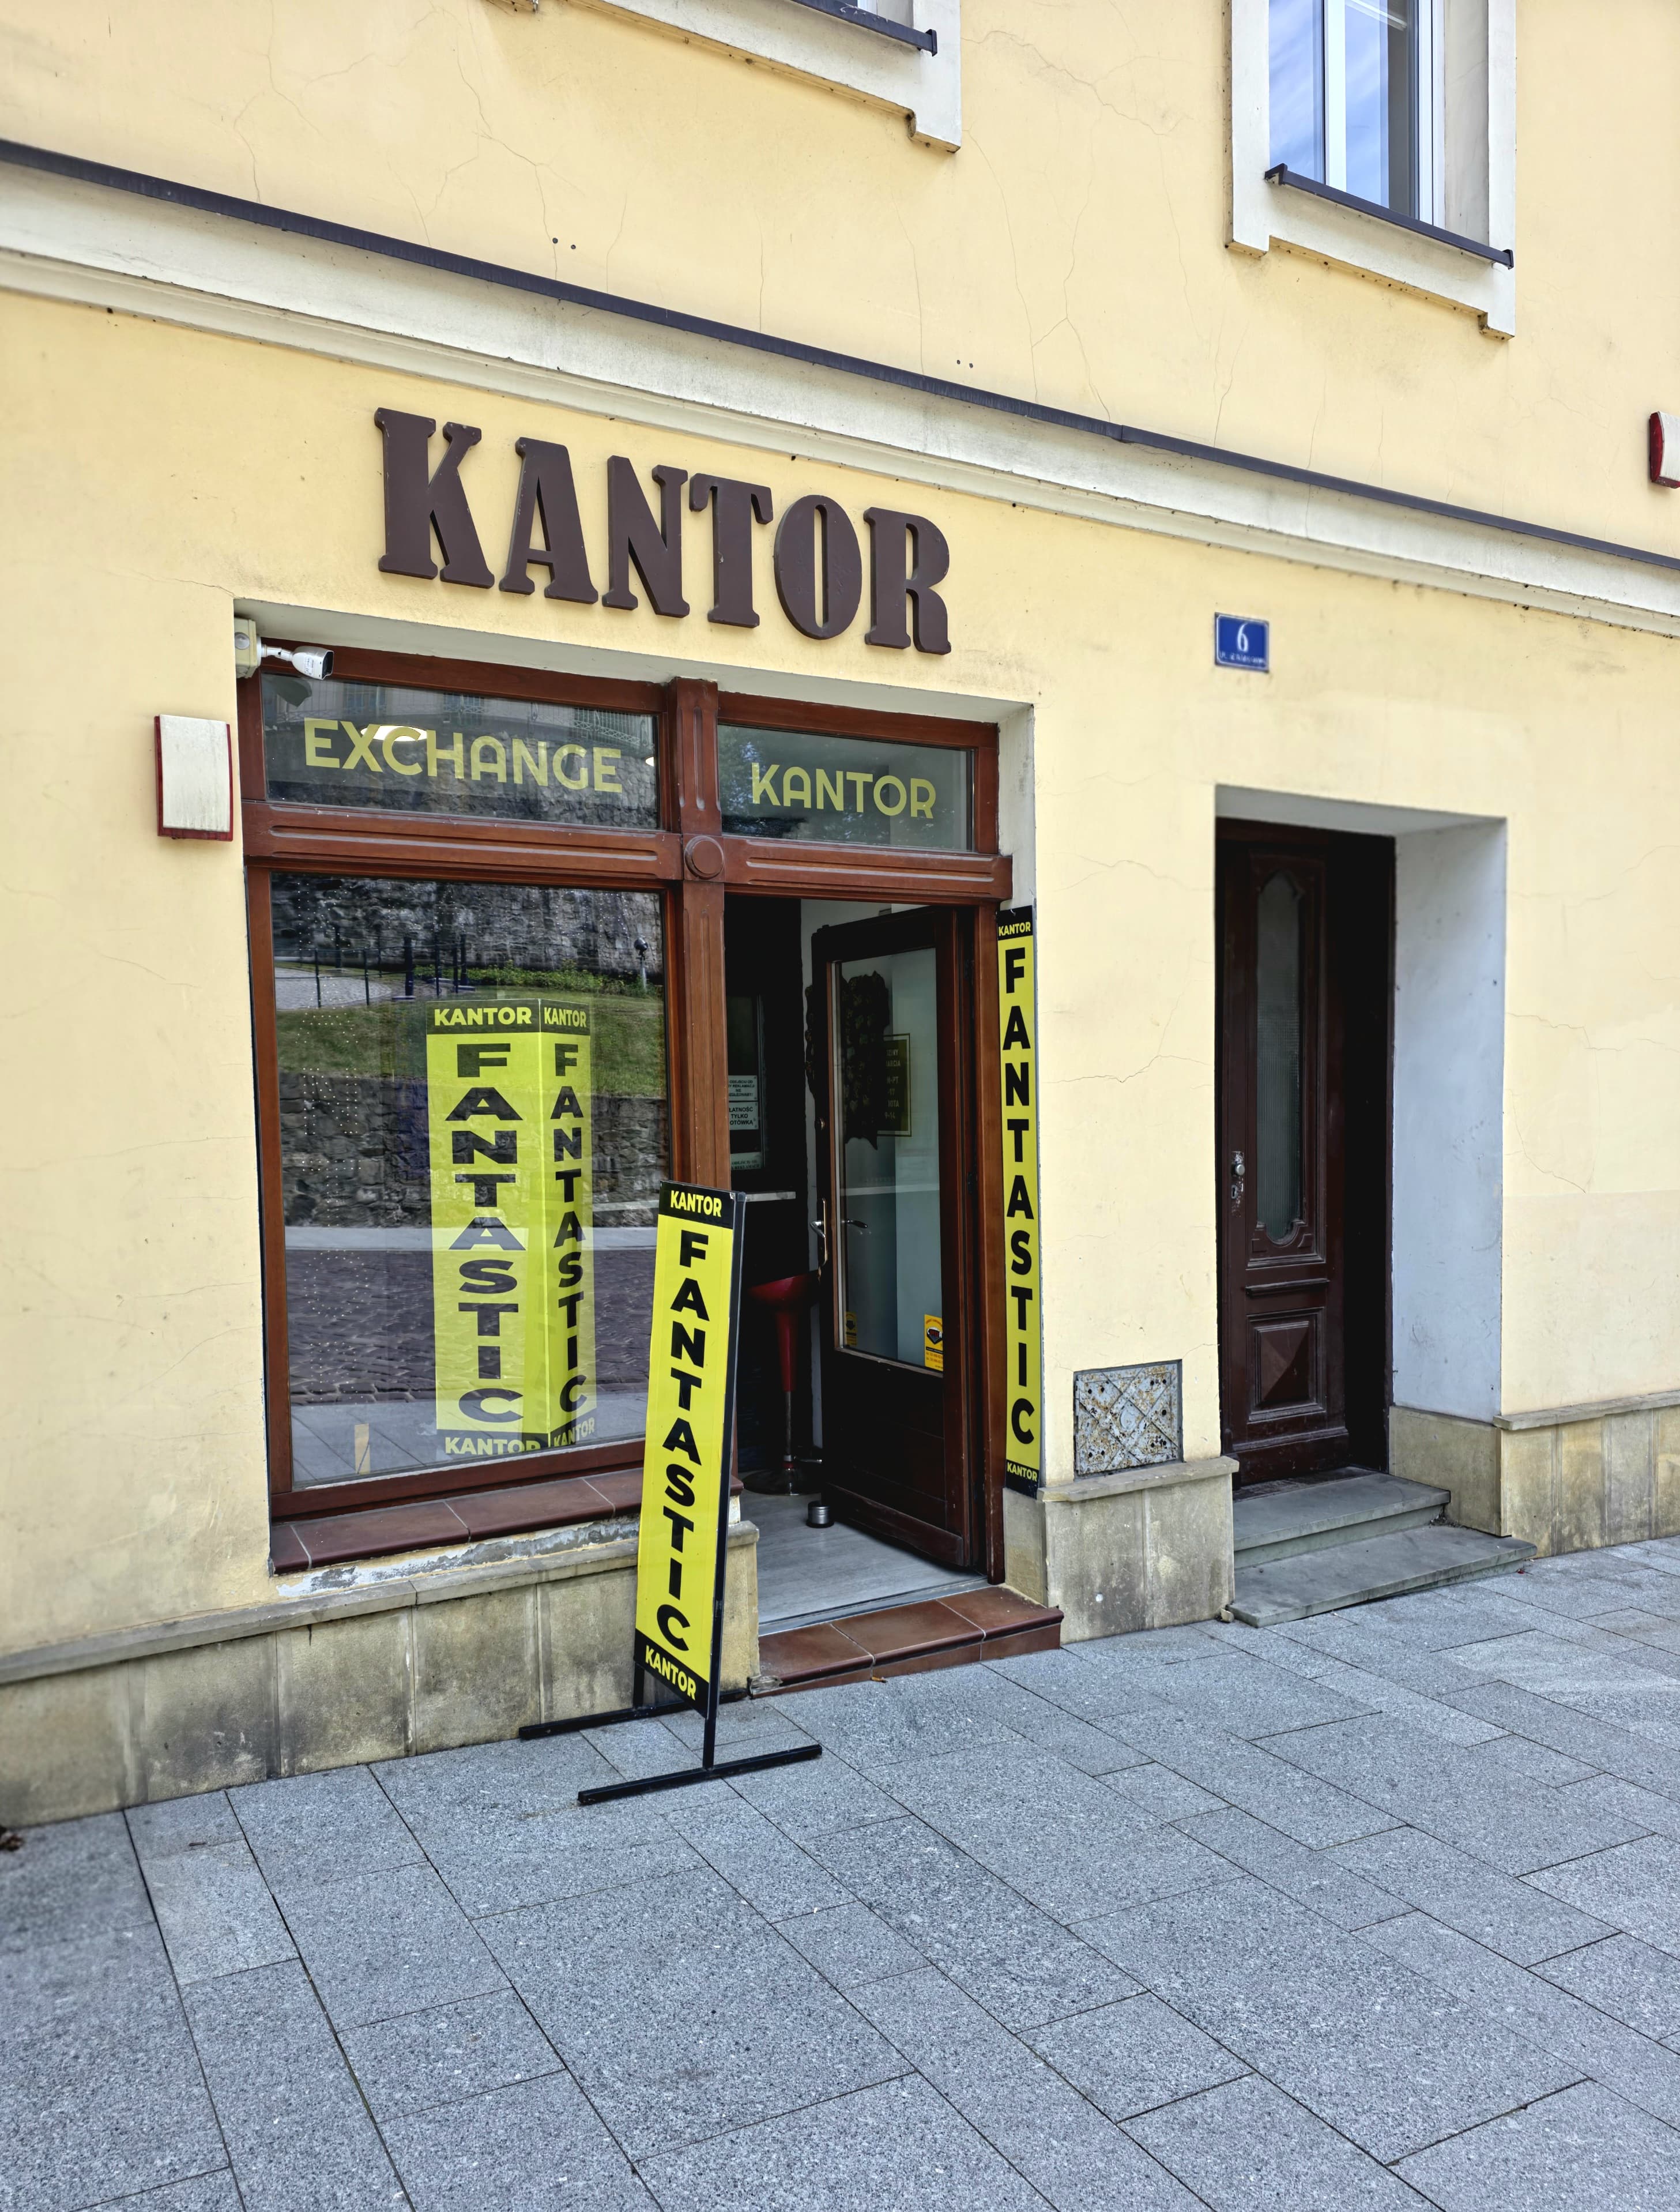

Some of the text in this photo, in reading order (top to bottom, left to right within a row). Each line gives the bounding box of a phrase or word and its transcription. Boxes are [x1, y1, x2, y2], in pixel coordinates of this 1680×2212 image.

[374, 407, 952, 654] KANTOR
[1237, 622, 1249, 653] 6
[304, 718, 624, 793] EXCHANGE
[751, 762, 936, 819] KANTOR
[998, 921, 1031, 936] KANTOR
[434, 1007, 532, 1026] KANTOR
[544, 1007, 587, 1028] KANTOR
[671, 1190, 722, 1217] KANTOR
[1003, 947, 1035, 1444] FANTASTIC
[445, 1043, 526, 1423] FANTASTIC
[549, 1043, 587, 1413] FANTASTIC
[656, 1229, 710, 1652] FANTASTIC
[1007, 1462, 1037, 1482] KANTOR
[646, 1645, 696, 1701] KANTOR
